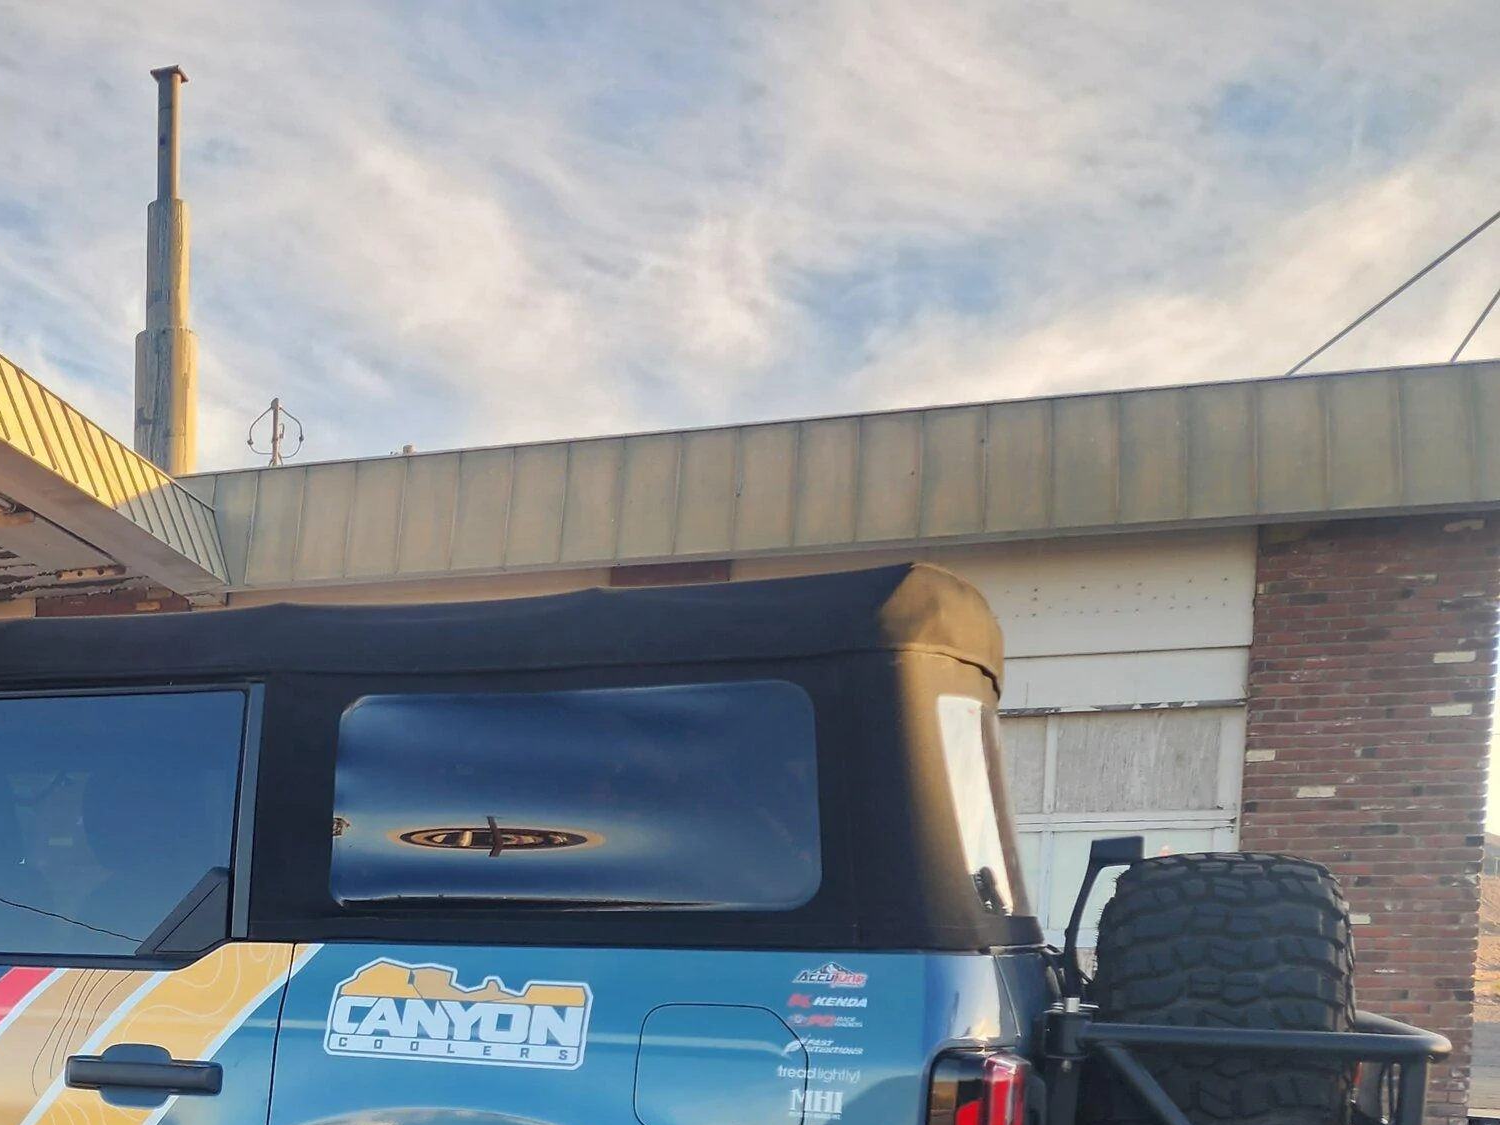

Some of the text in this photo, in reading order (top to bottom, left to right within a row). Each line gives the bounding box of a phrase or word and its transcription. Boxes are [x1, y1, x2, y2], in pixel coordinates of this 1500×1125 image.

[812, 996, 868, 1008] KENDA
[332, 995, 585, 1047] CANYON
[338, 1036, 568, 1061] COOLERS
[789, 1089, 842, 1114] MHI
